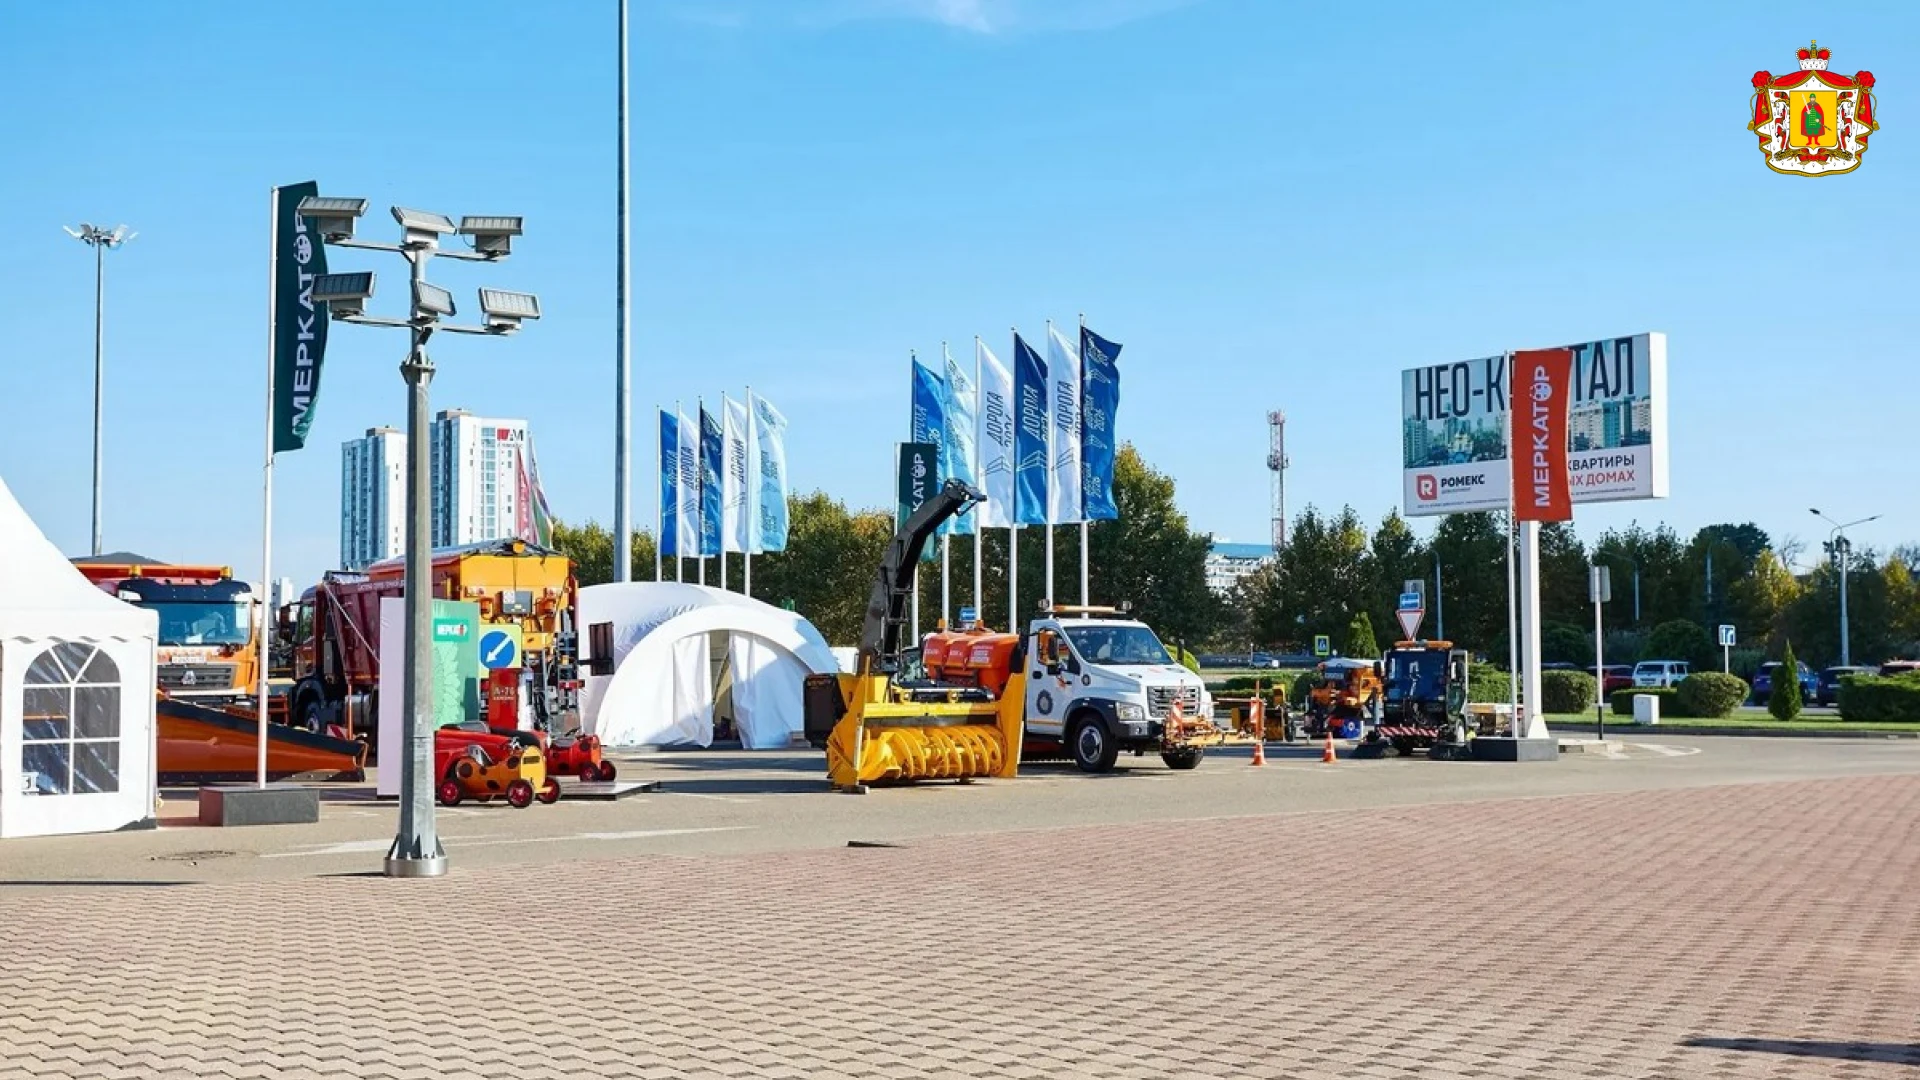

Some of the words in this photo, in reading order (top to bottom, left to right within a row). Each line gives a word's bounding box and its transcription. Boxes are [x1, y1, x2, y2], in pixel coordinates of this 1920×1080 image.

[292, 208, 316, 436] МЕРКАТОР
[1415, 337, 1635, 421] НЕО-КТАЛ
[986, 390, 1004, 447] ДОРОГА
[1022, 384, 1041, 442] ДОРОГА
[1531, 364, 1553, 508] МЕРКАТОР
[912, 452, 927, 512] КАТОР
[1441, 474, 1485, 488] РОМЕКС
[1585, 469, 1635, 487] ДОМАХ
